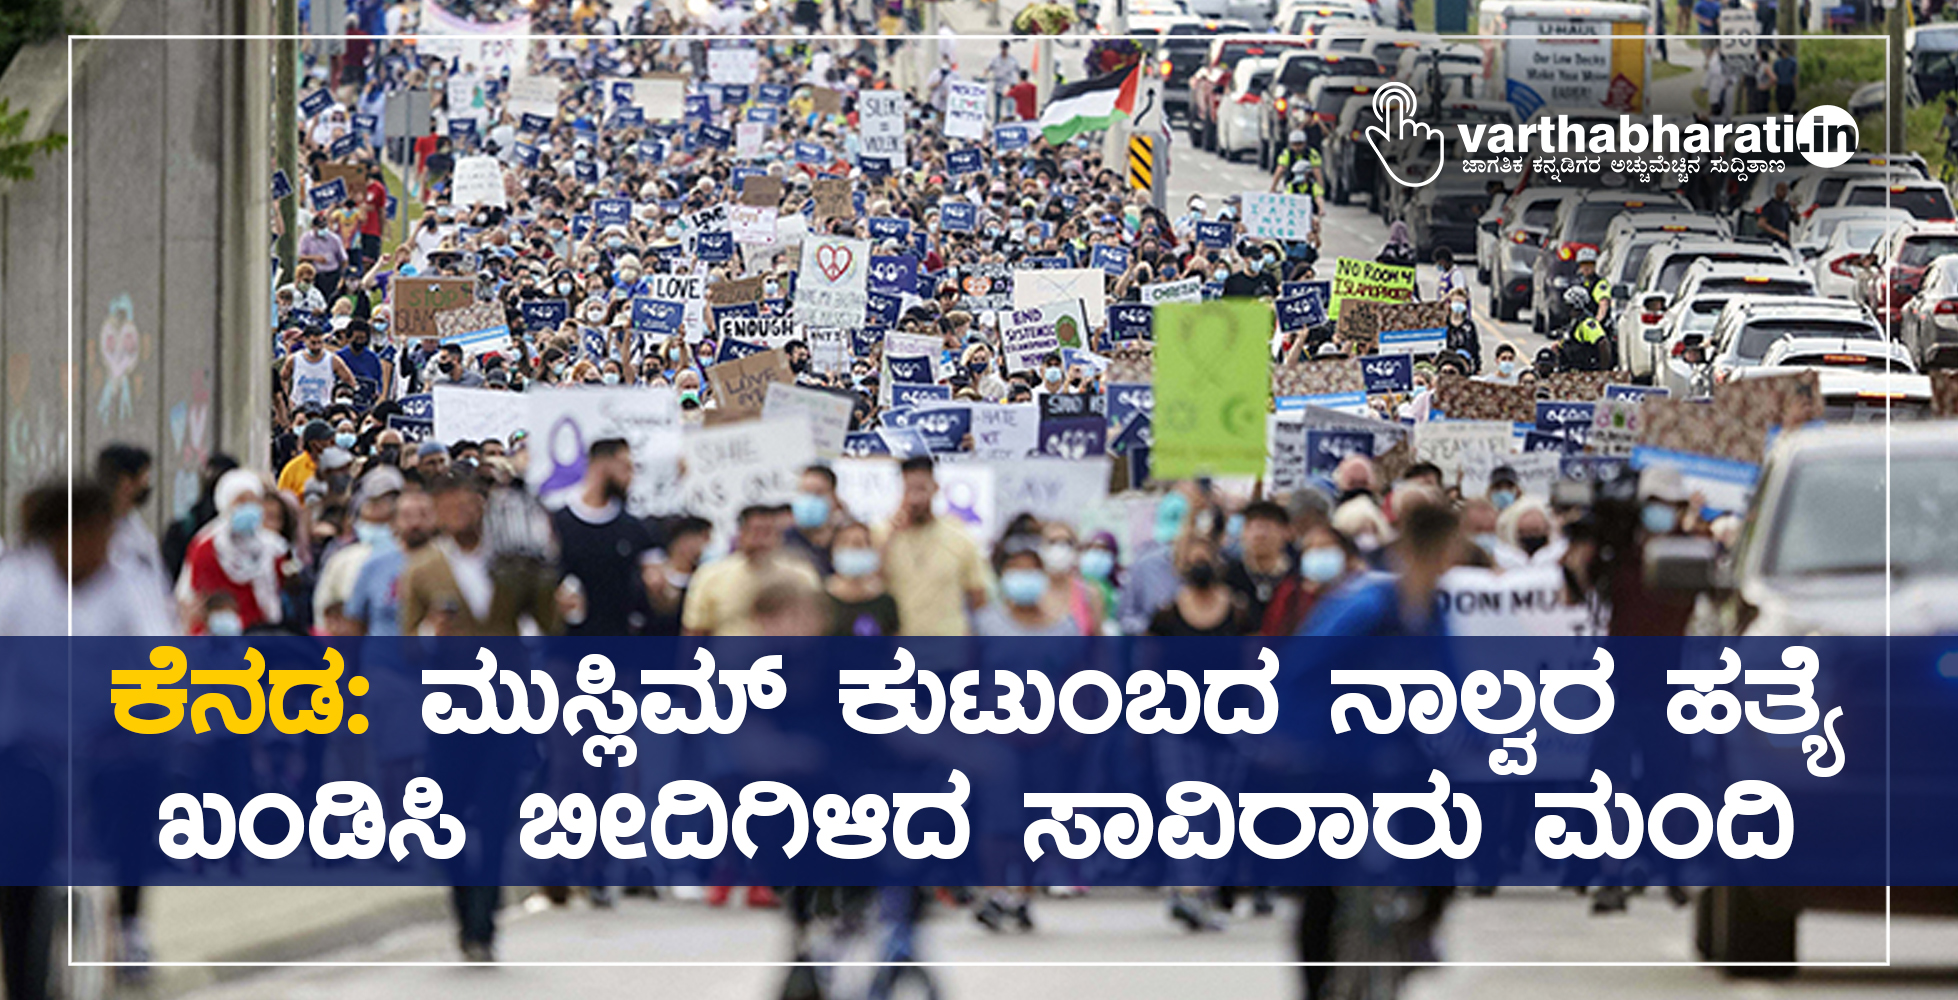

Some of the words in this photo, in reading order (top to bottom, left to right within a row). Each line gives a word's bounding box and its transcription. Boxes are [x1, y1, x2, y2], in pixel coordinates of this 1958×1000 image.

[1723, 28, 1752, 48] 50
[1337, 260, 1361, 277] NO
[1364, 263, 1399, 284] ROOM
[408, 288, 459, 307] STOP
[657, 278, 700, 299] LOVE
[1012, 308, 1043, 326] END
[722, 319, 794, 338] ENOUGH
